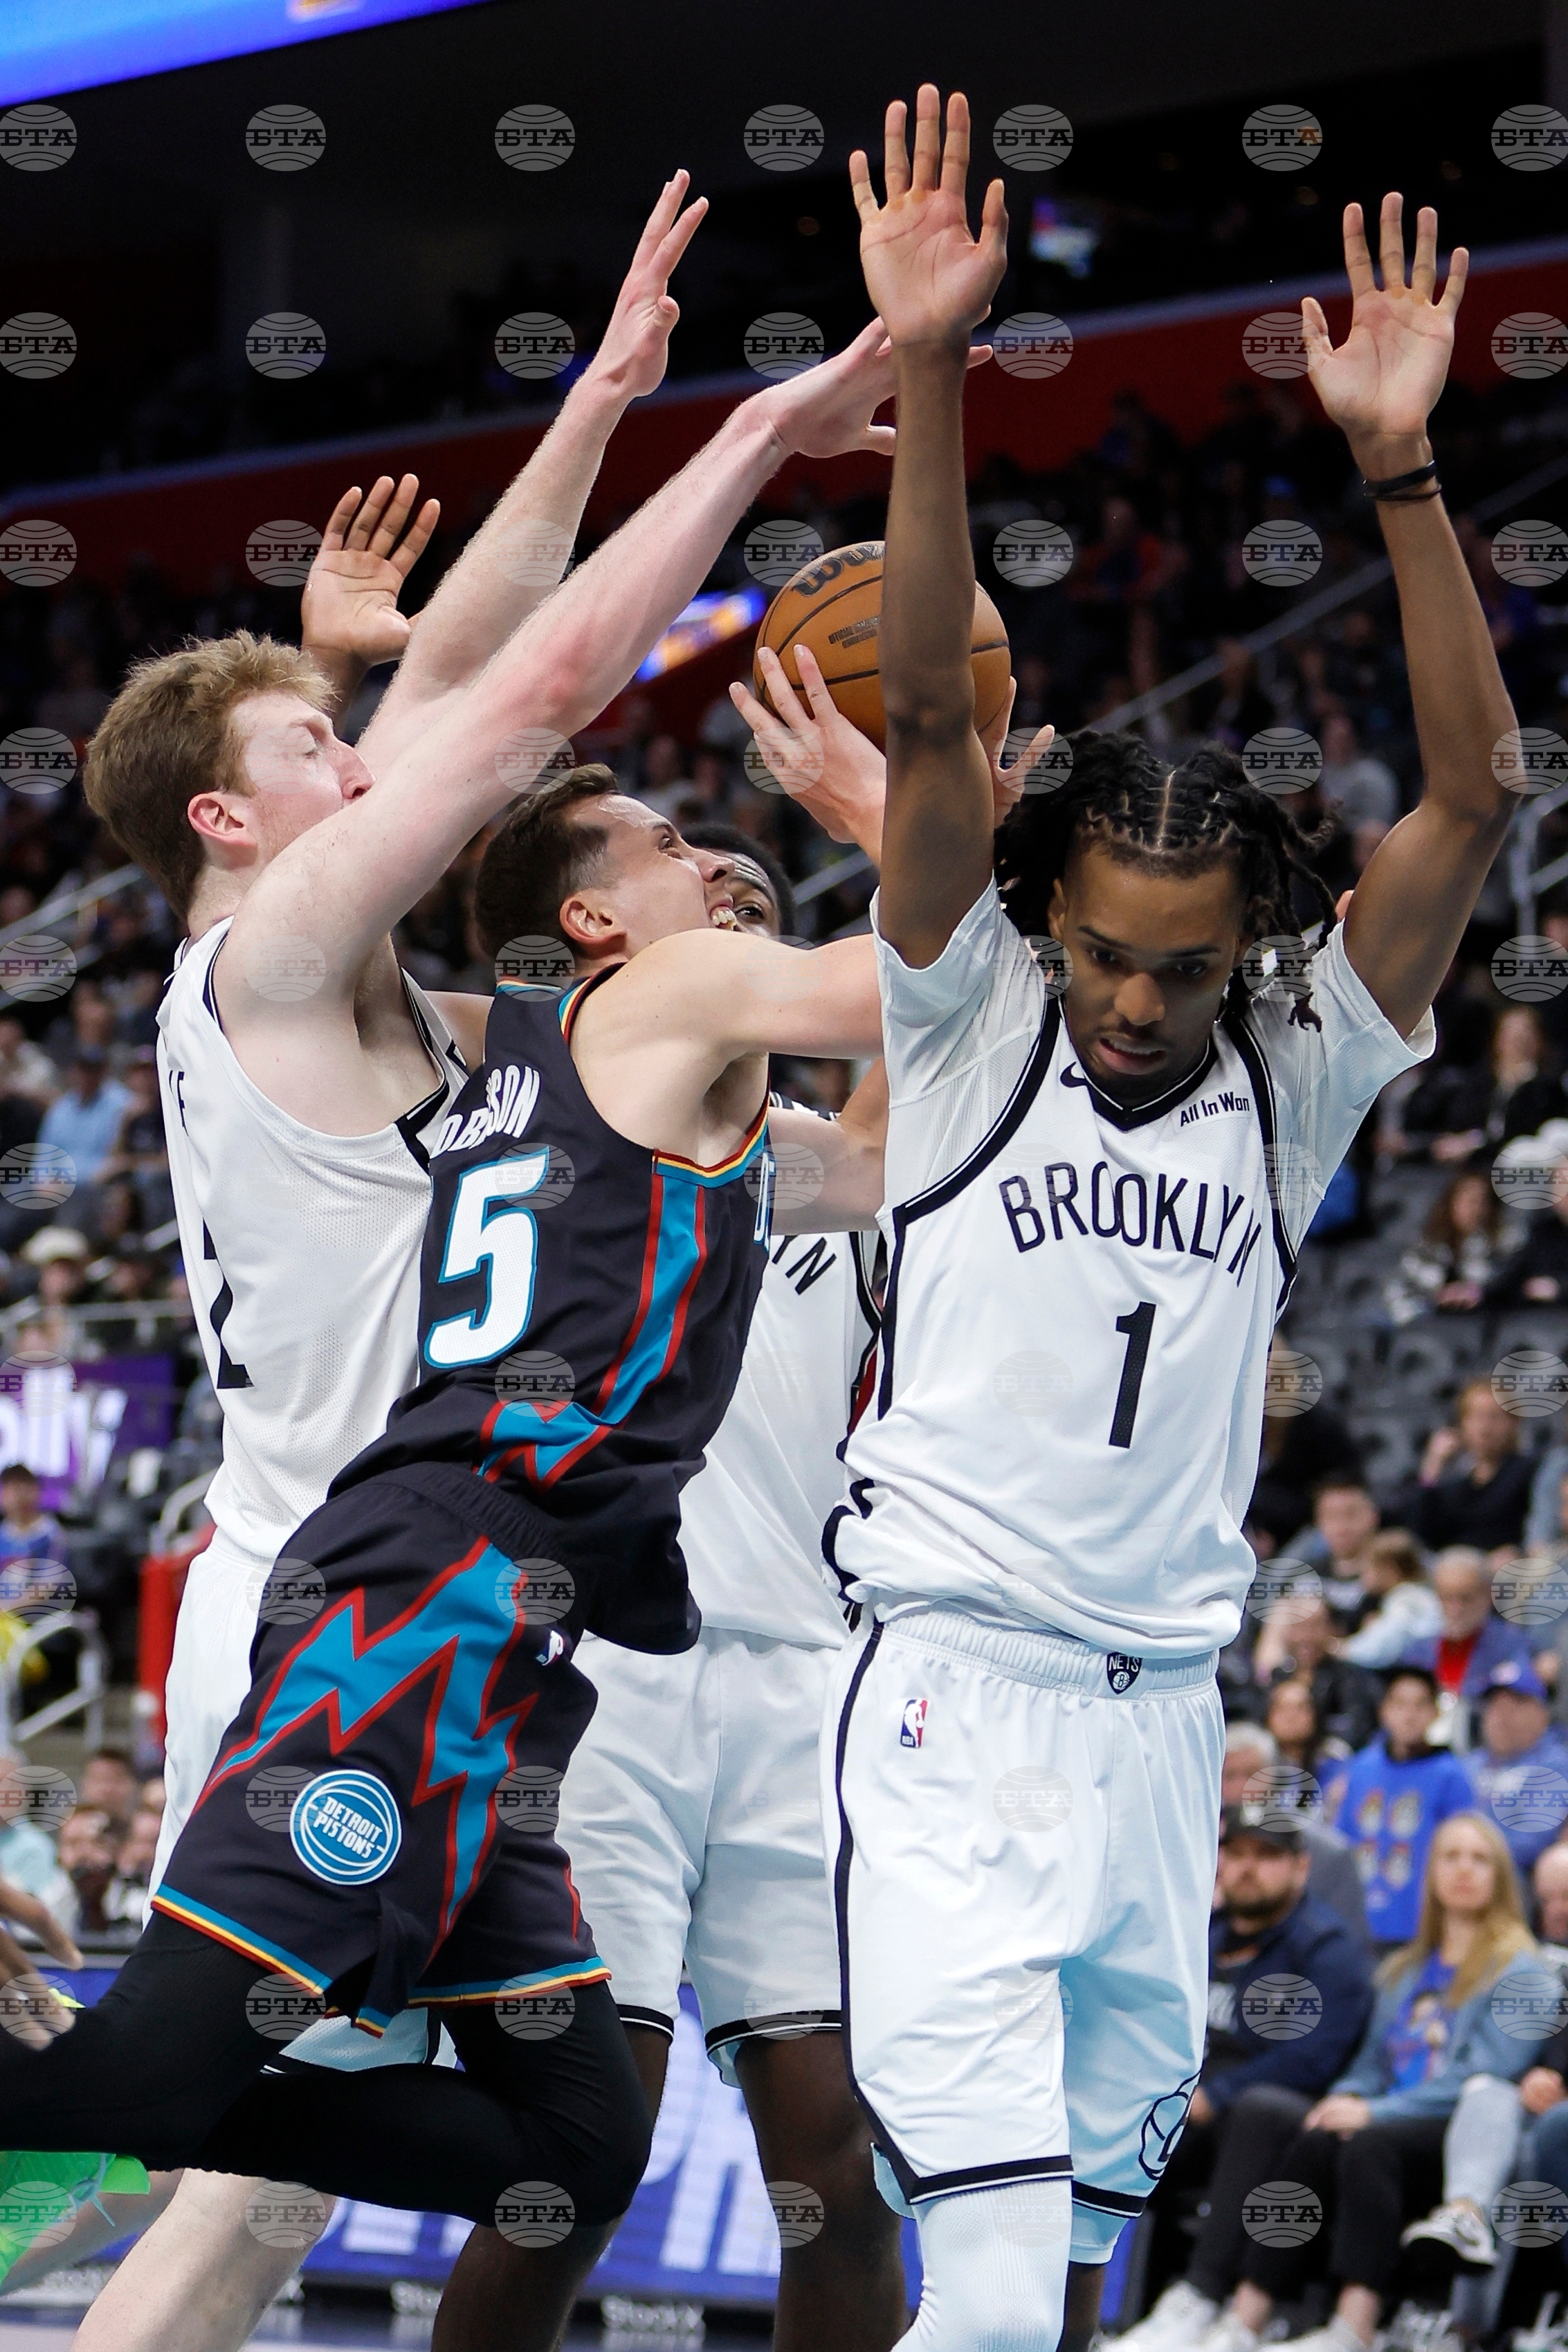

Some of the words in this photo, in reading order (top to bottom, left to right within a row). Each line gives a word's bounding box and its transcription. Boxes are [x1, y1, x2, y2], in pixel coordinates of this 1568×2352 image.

[430, 1065, 540, 1159] OBSON
[1180, 1103, 1200, 1128] All
[1201, 1099, 1219, 1117] In
[1217, 1091, 1250, 1112] Won
[423, 1145, 550, 1369] 5
[999, 1160, 1262, 1288] BROOKLYN
[1109, 1301, 1157, 1449] 1
[1108, 1654, 1139, 1673] NETS
[313, 1811, 375, 1859] PISTONS
[322, 1795, 383, 1843] DETROIT
